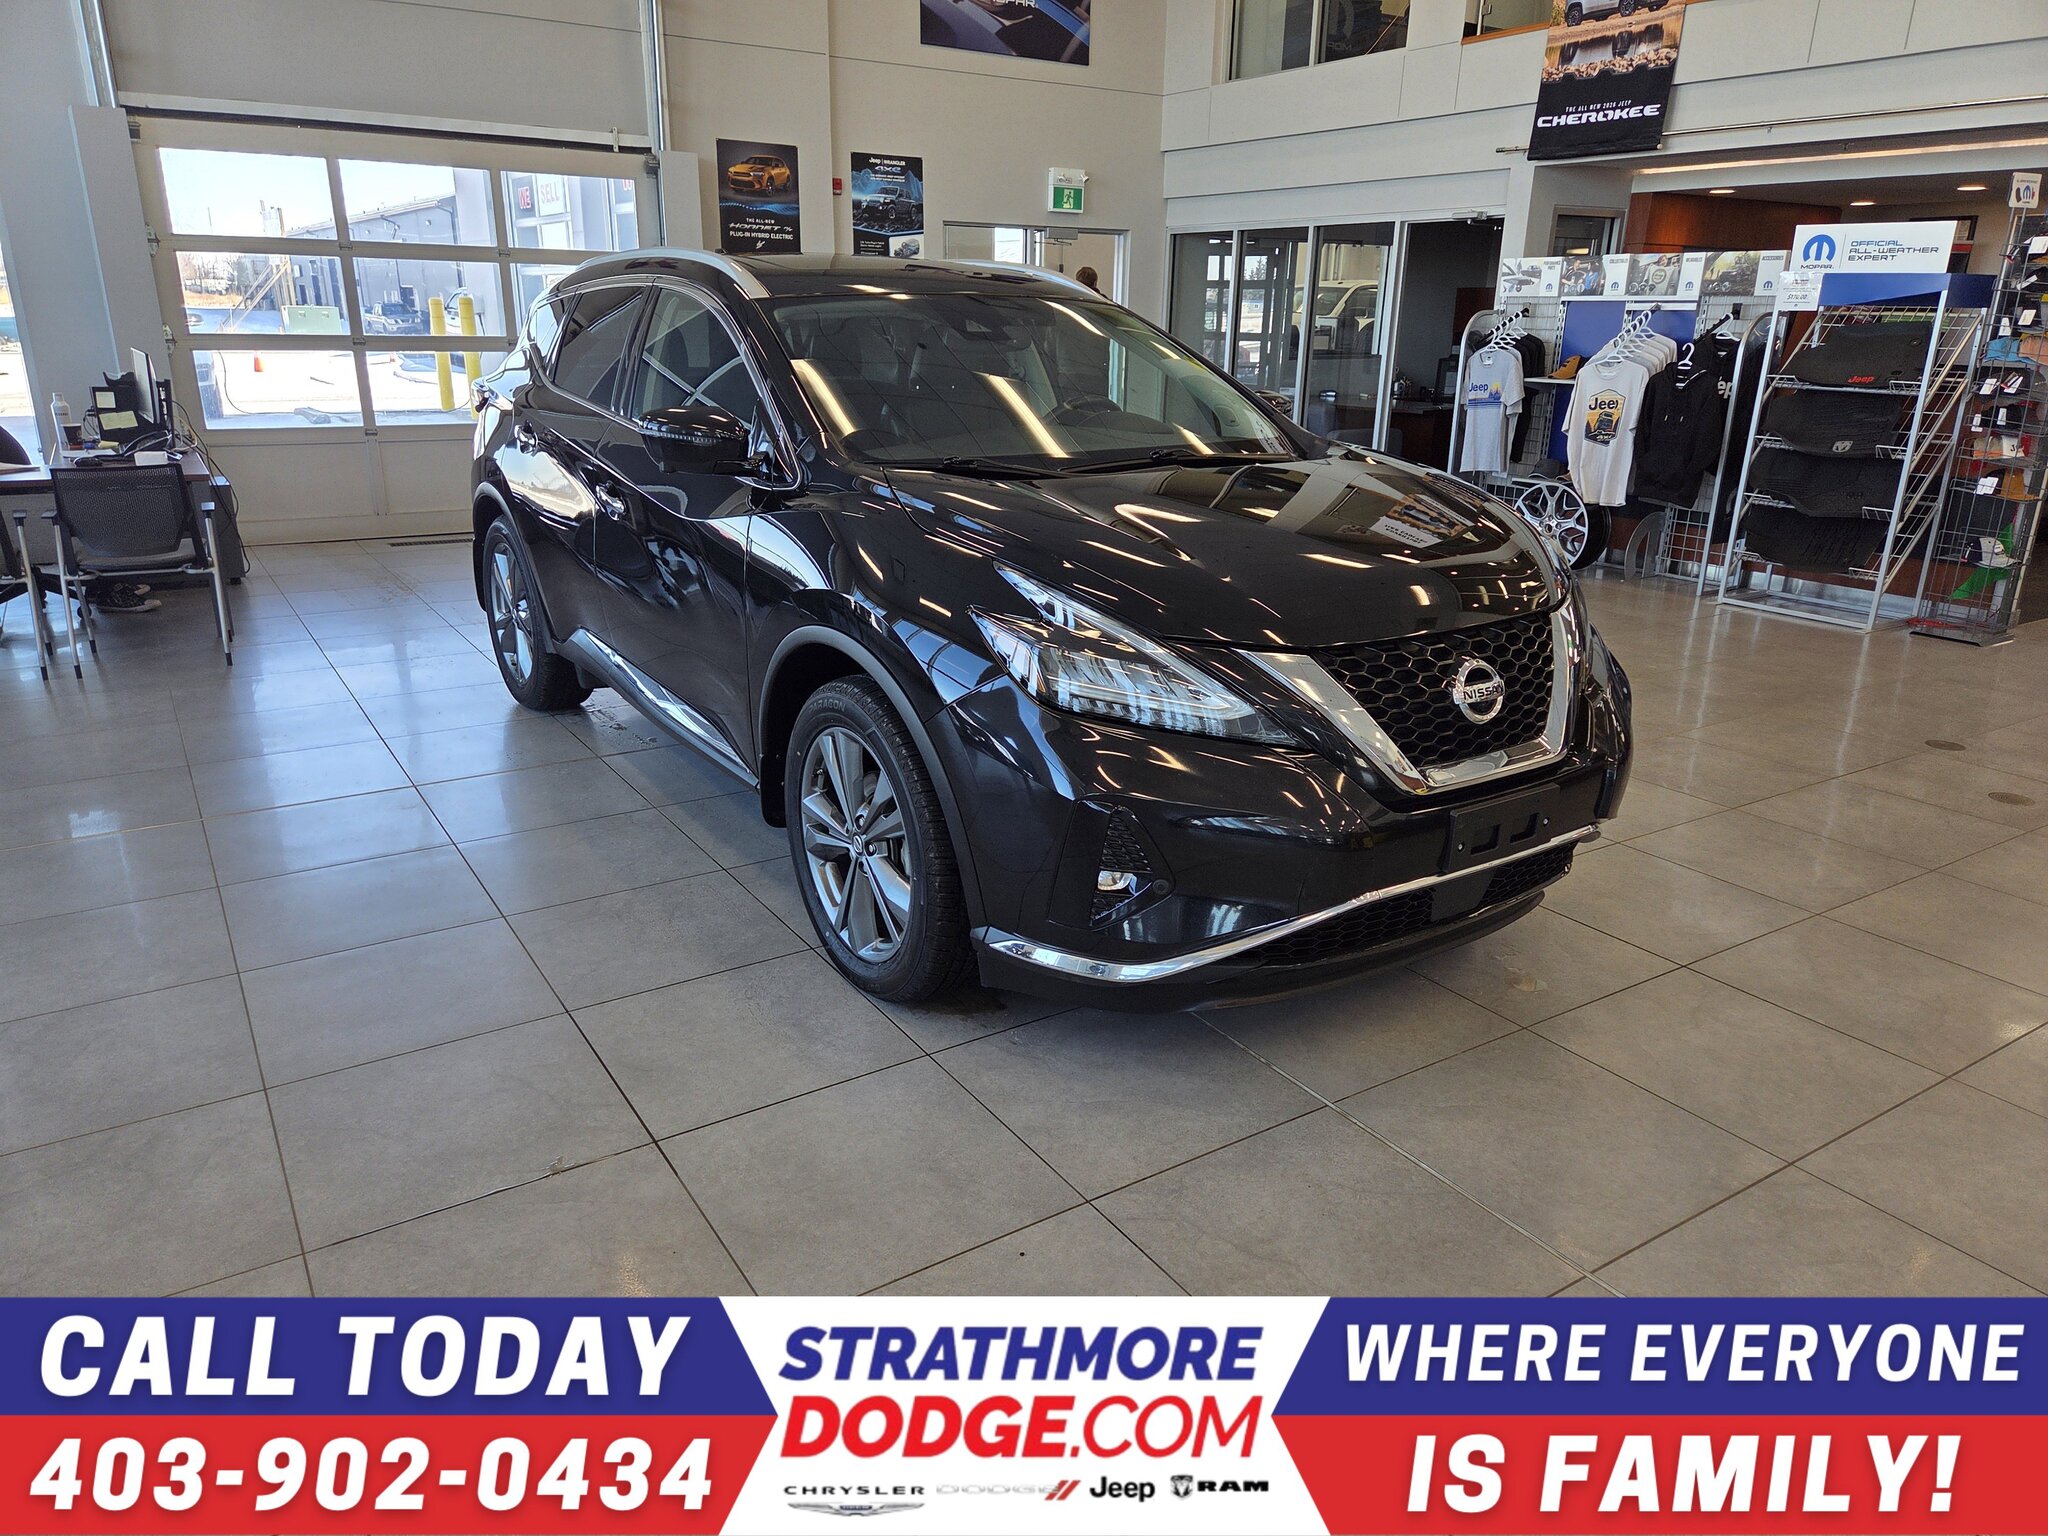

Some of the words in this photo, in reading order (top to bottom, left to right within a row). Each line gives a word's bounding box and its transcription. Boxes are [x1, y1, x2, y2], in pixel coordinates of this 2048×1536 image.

[1618, 99, 1632, 107] JEEP
[1536, 104, 1661, 128] CHEROKEE
[540, 181, 560, 204] SELL
[729, 230, 750, 238] PLUG-IN
[751, 231, 770, 239] HYBRID
[1848, 254, 1897, 262] EXPERT
[1847, 375, 1875, 384] Jeep
[1469, 382, 1489, 393] Jeep
[1463, 684, 1504, 700] NISSAN
